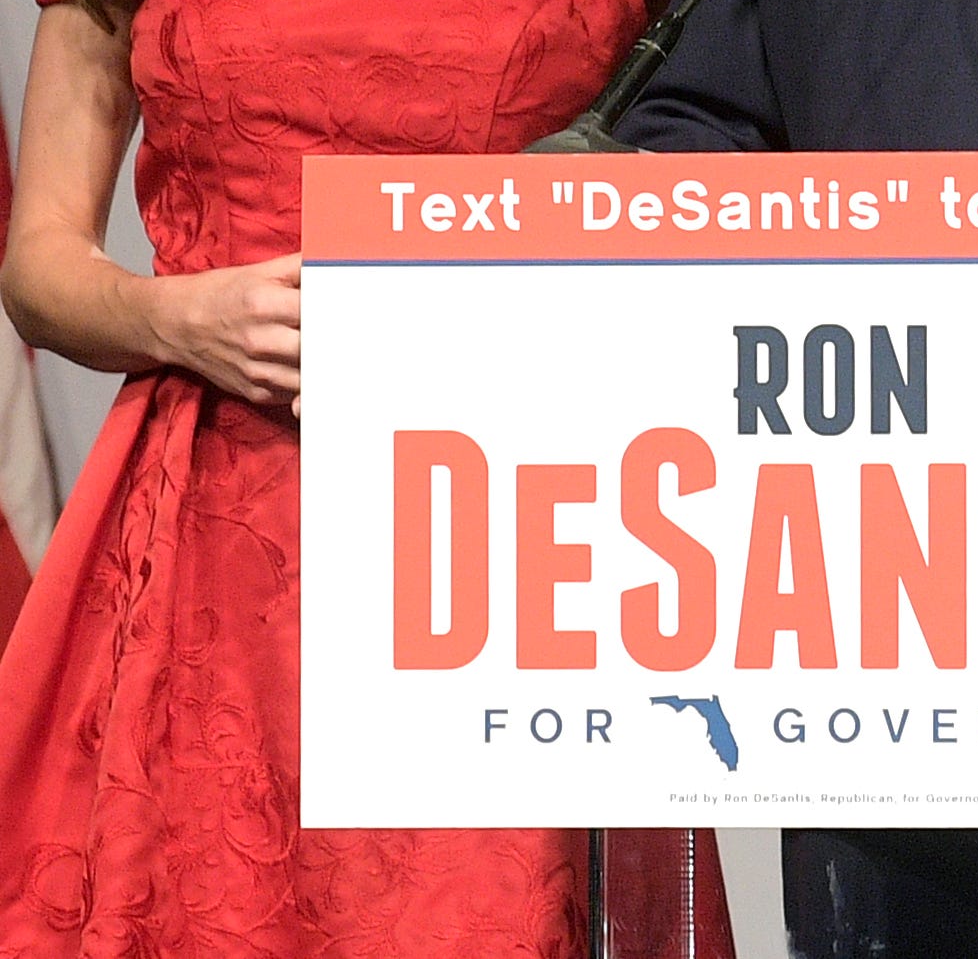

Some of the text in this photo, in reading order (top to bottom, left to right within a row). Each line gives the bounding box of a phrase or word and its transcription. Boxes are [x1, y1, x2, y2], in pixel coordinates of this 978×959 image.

[381, 179, 520, 232] Text
[552, 176, 909, 232] "DeSantis"
[733, 324, 928, 436] RON
[485, 709, 613, 744] FOR
[669, 793, 698, 803] Paid
[703, 793, 718, 806] by
[724, 793, 748, 803] Ron
[902, 793, 920, 803] for
